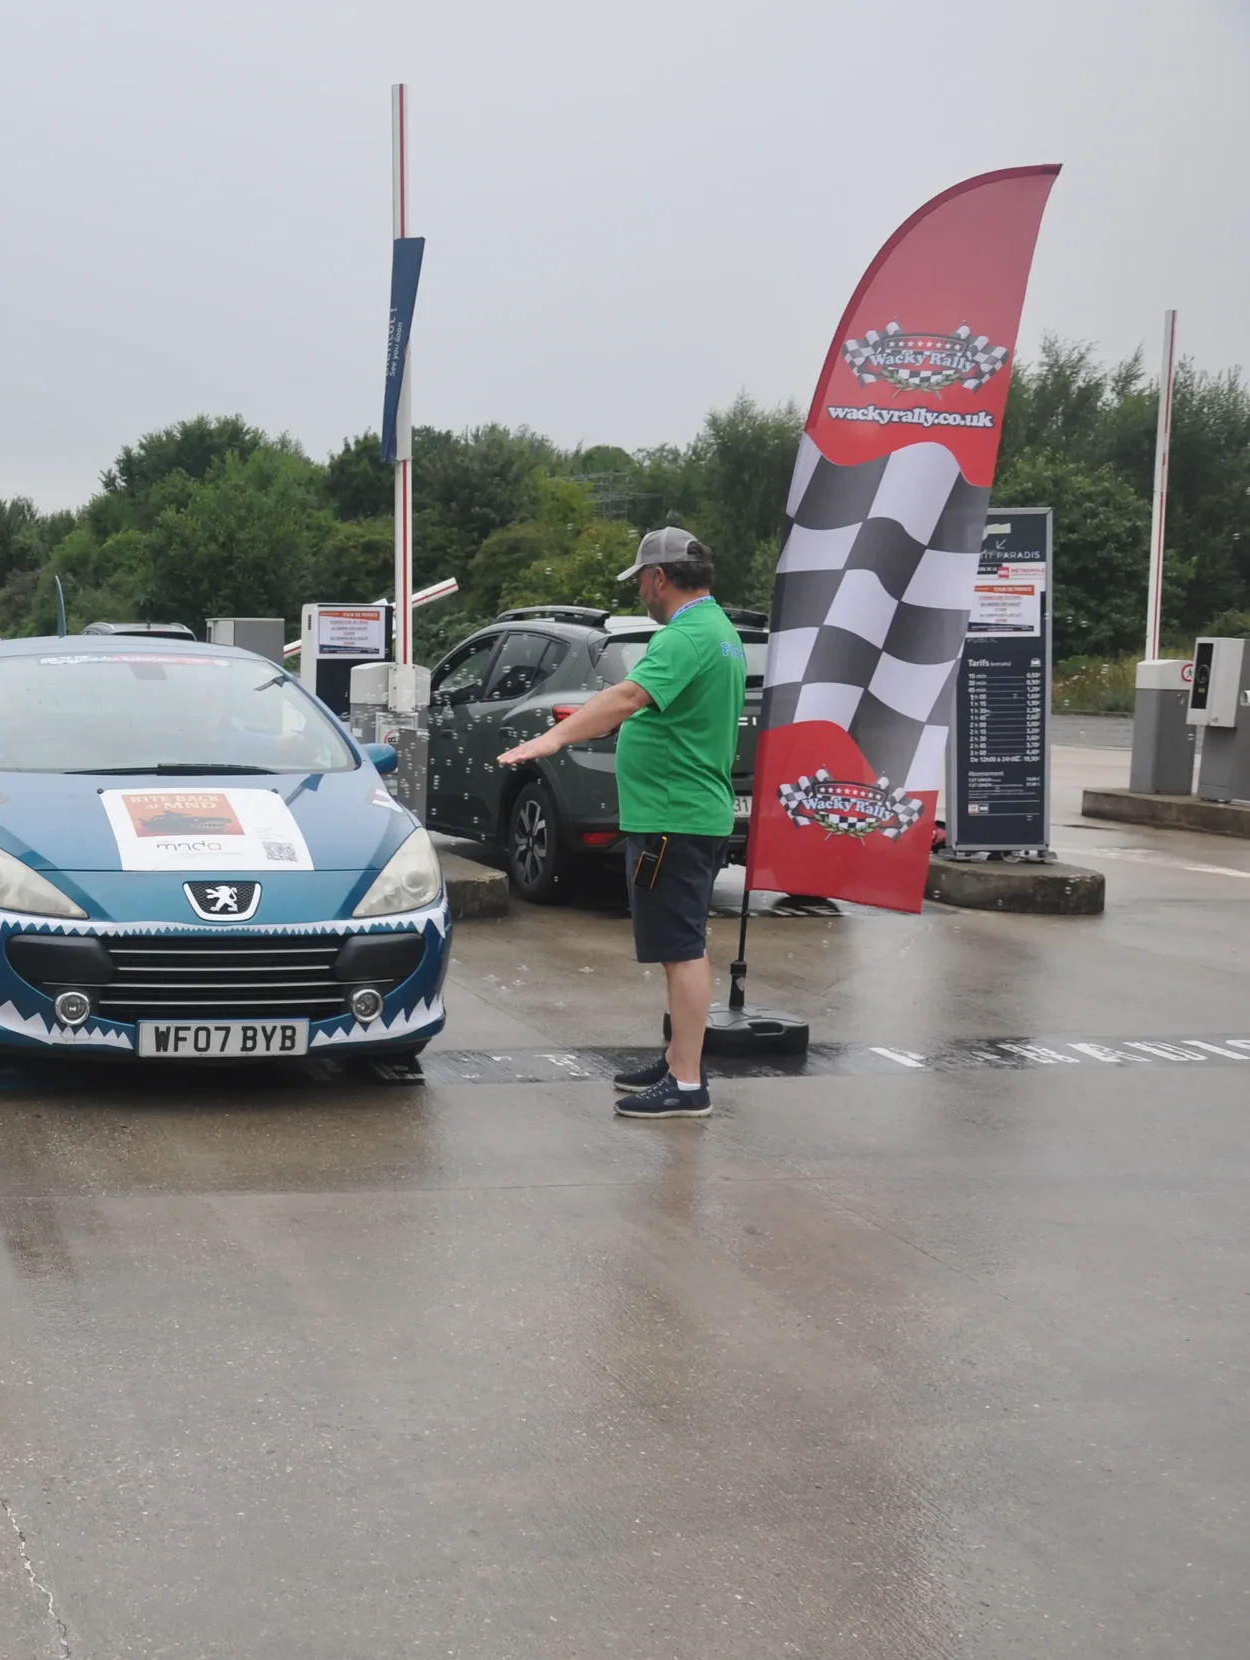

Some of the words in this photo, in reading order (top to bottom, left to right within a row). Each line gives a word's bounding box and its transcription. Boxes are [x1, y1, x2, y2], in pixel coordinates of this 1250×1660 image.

[389, 361, 397, 376] See
[394, 322, 403, 342] soon
[869, 351, 924, 367] Wacky
[929, 352, 976, 372] Rally
[827, 404, 994, 428] wackyrally.co.uk
[130, 795, 171, 804] BITE
[175, 795, 221, 803] BACK
[164, 802, 216, 810] MND
[802, 795, 852, 811] Wacky
[855, 800, 894, 821] Rally
[154, 1026, 231, 1053] WF07
[240, 1025, 297, 1052] BYB
